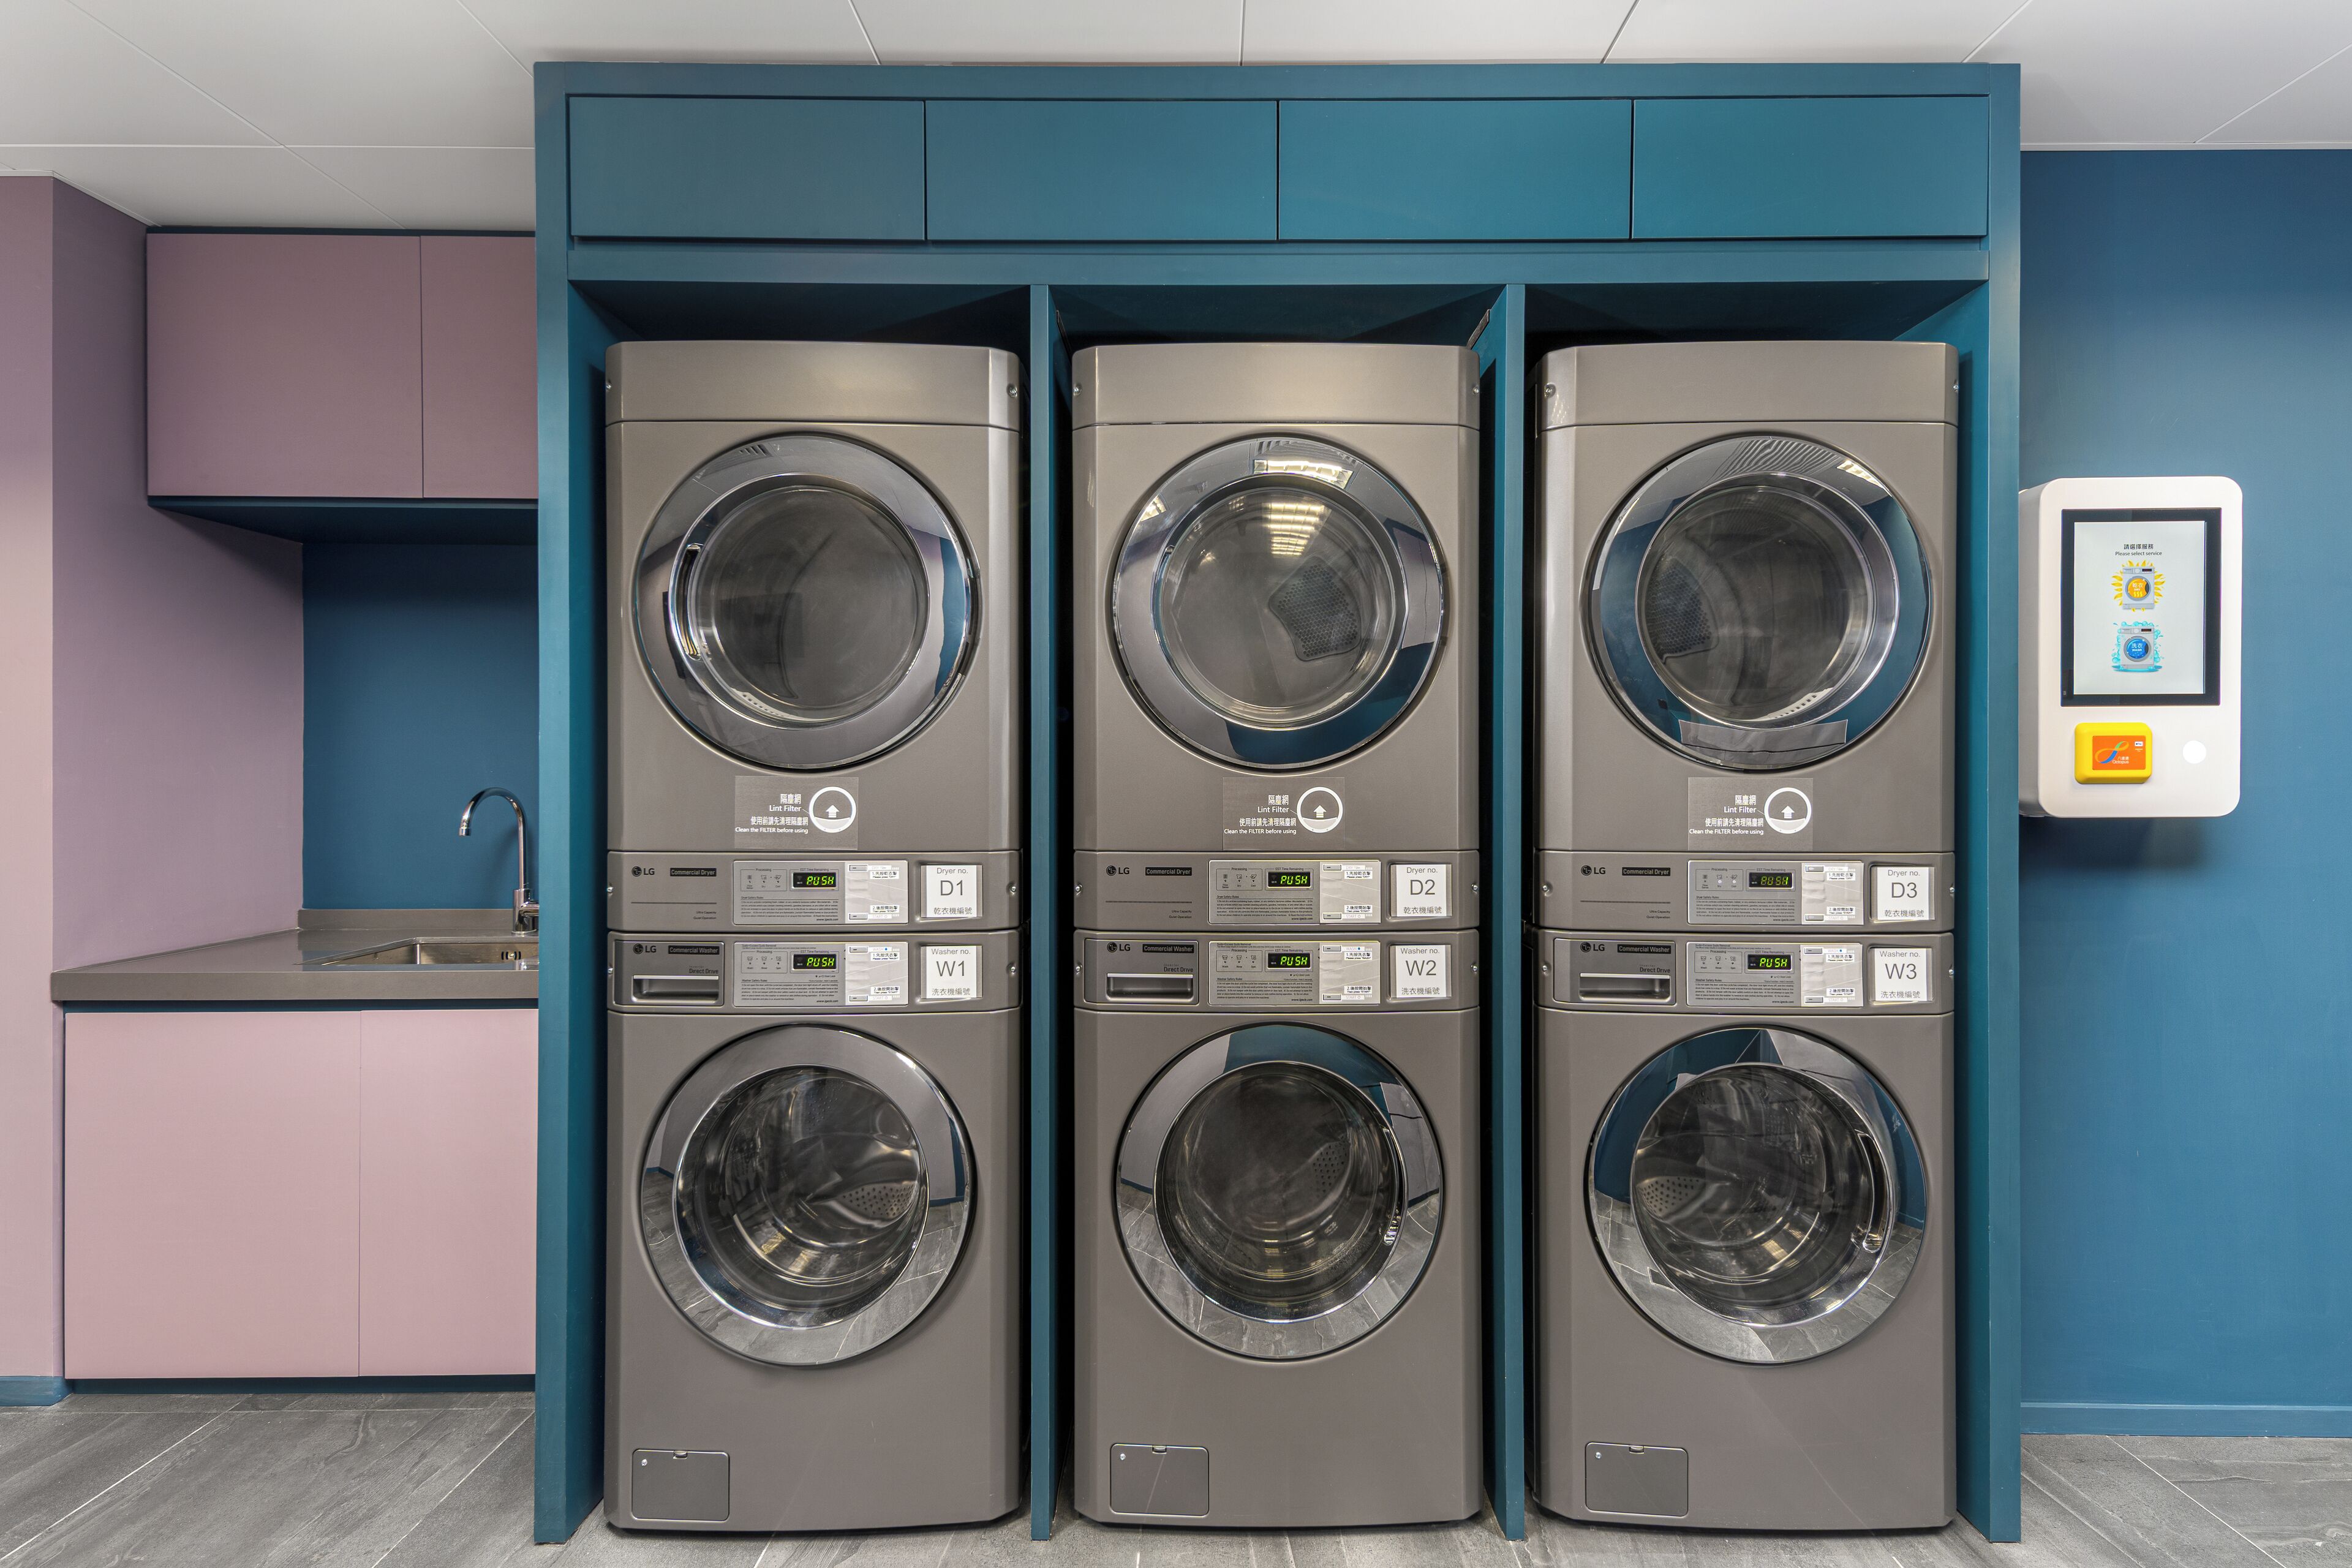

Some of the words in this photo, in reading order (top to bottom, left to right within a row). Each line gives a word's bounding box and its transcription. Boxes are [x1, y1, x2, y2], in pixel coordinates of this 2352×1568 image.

[780, 794, 802, 804] 隔塵網
[1268, 795, 1289, 805] 隔塵網
[1735, 795, 1757, 805] 隔塵網
[751, 816, 809, 826] 使用前請先清理隔塵網
[1240, 818, 1297, 826] 使用前請先清理隔塵網
[1705, 818, 1764, 827] 使用前請先清理隔塵網
[807, 876, 835, 885] PUSH
[1281, 876, 1308, 884] PUSH
[941, 880, 963, 896] D1
[1410, 880, 1436, 895] D2
[1892, 883, 1917, 898] D3
[807, 958, 835, 967] PUSH
[1281, 957, 1308, 966] PUSH
[1760, 958, 1787, 967] PUSH
[937, 961, 965, 976] W1
[1406, 960, 1436, 976] W2
[1885, 963, 1917, 979] W3
